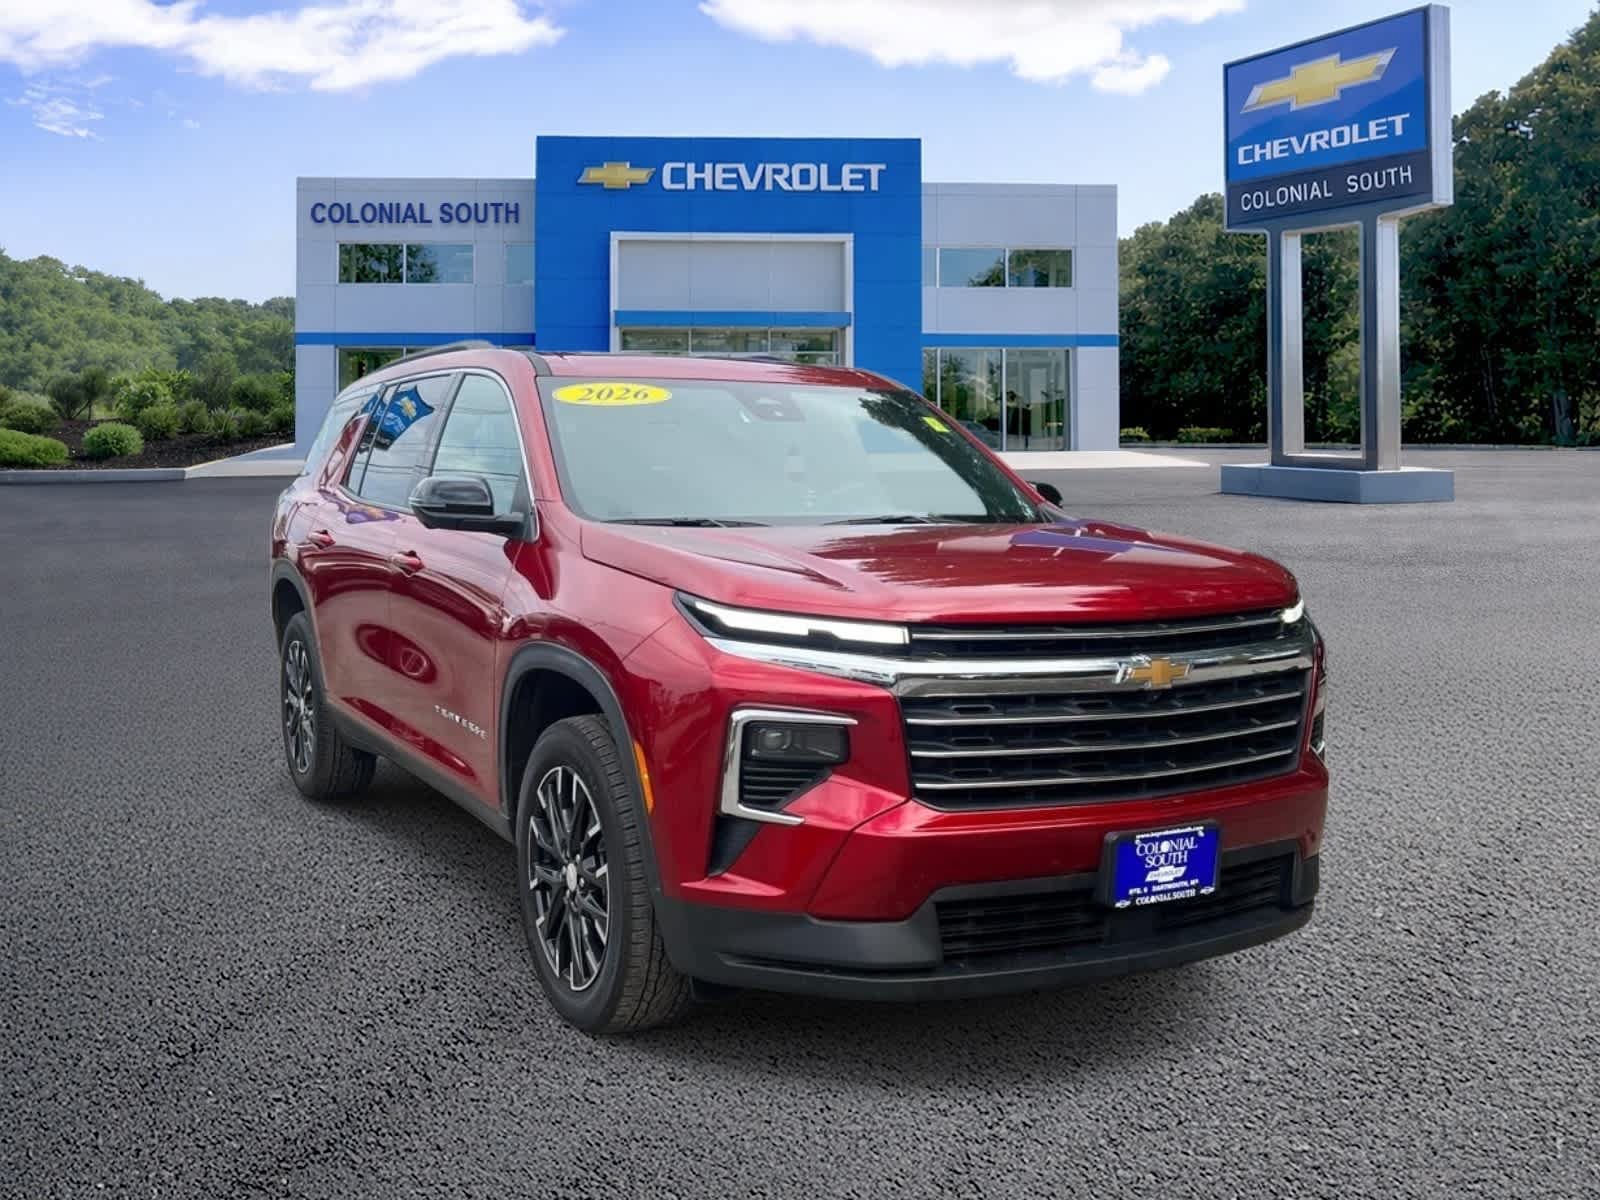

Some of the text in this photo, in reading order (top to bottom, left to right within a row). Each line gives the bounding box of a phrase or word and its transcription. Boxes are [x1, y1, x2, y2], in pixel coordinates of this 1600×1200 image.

[1237, 113, 1410, 165] CHEVROLET
[662, 161, 887, 192] CHEVROLET
[1240, 165, 1413, 212] COLONIAL SOUTH
[310, 202, 520, 225] COLONIAL SOUTH
[577, 387, 649, 401] 2026
[1136, 837, 1198, 857] COLONIAL
[1145, 850, 1188, 869] SOUTH
[1135, 887, 1197, 906] COLONIAL SOUTH
